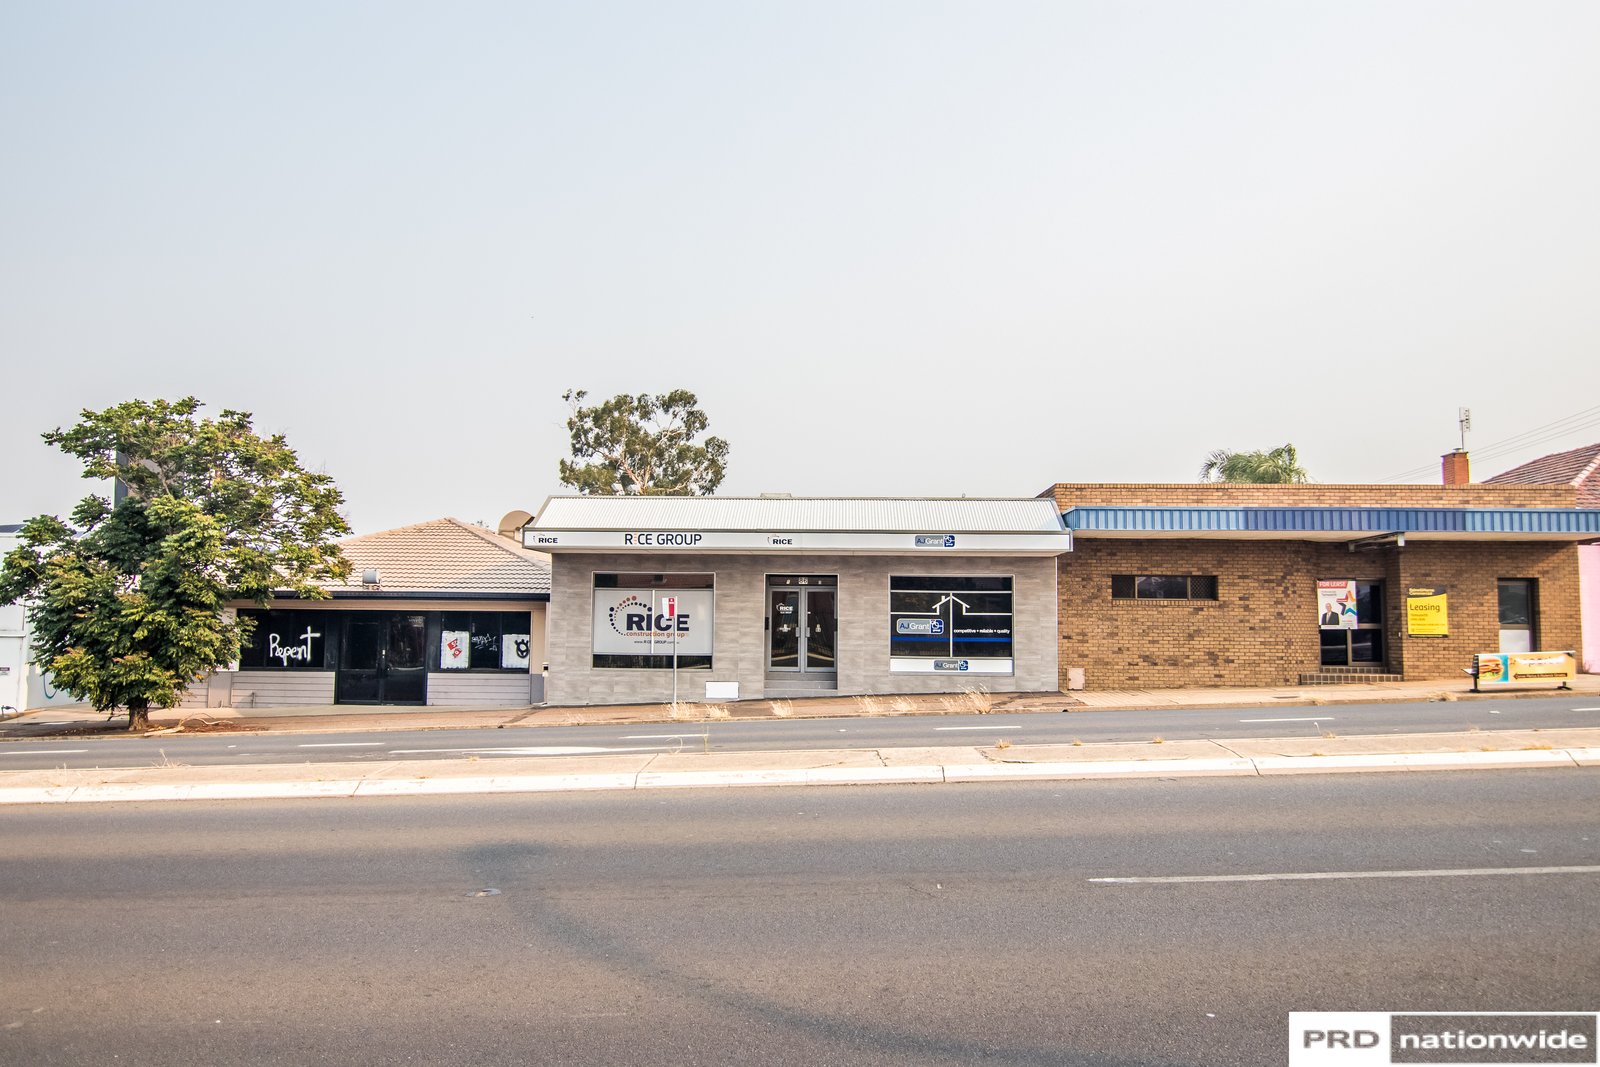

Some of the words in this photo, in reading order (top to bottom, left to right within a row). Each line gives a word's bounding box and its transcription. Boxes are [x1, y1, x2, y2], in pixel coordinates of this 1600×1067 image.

[624, 533, 653, 545] RICE
[656, 533, 702, 545] GROUP
[1409, 603, 1441, 613] Leasing
[626, 613, 690, 632] RICE
[269, 625, 321, 667] Repent
